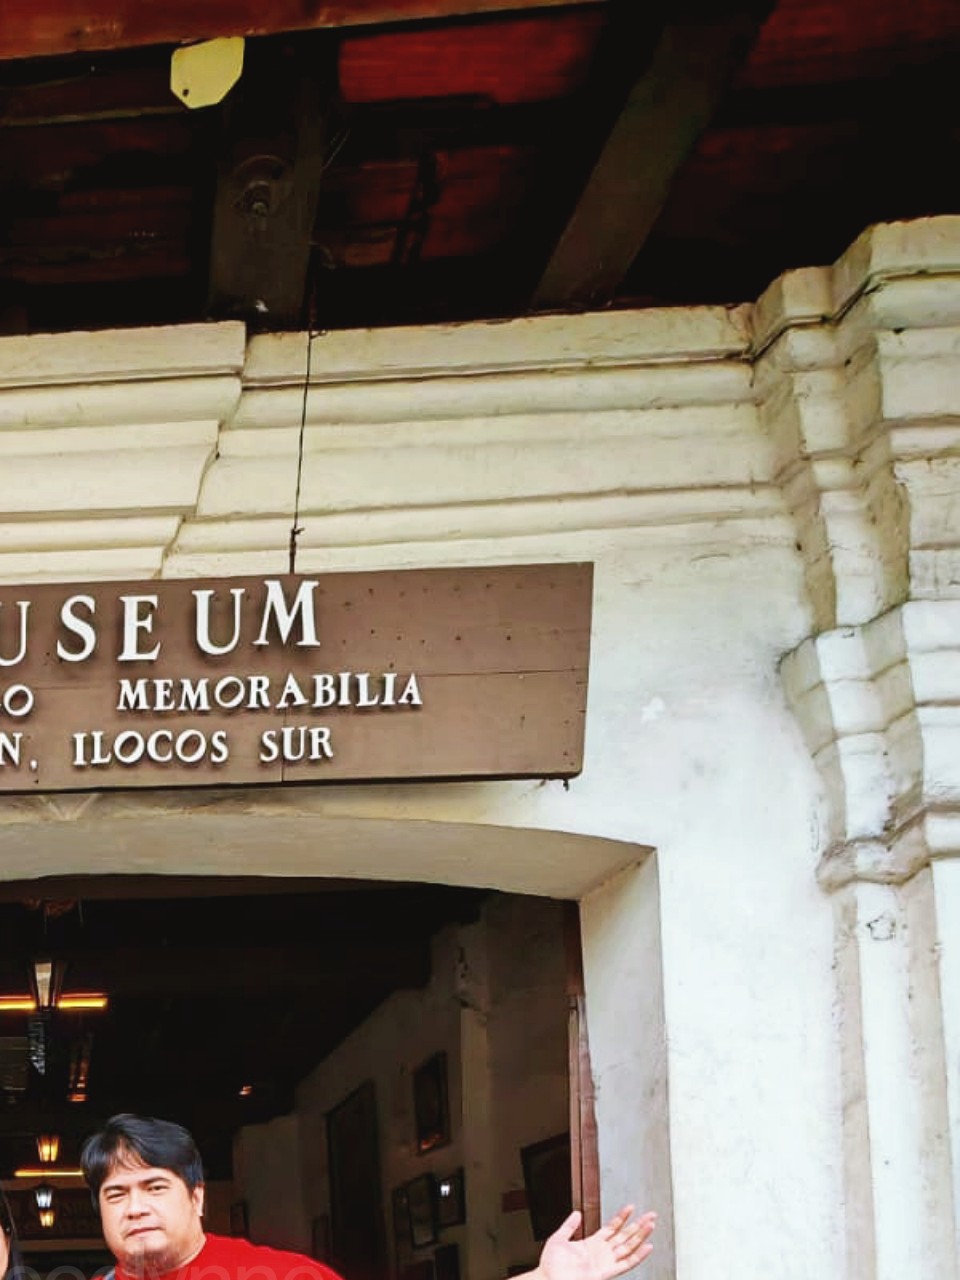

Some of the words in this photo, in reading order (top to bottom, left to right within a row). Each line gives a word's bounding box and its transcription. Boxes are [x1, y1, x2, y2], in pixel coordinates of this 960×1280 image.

[116, 672, 423, 711] MEMORABILIA
[73, 729, 229, 766] ILOCOS
[259, 726, 334, 762] SUR
